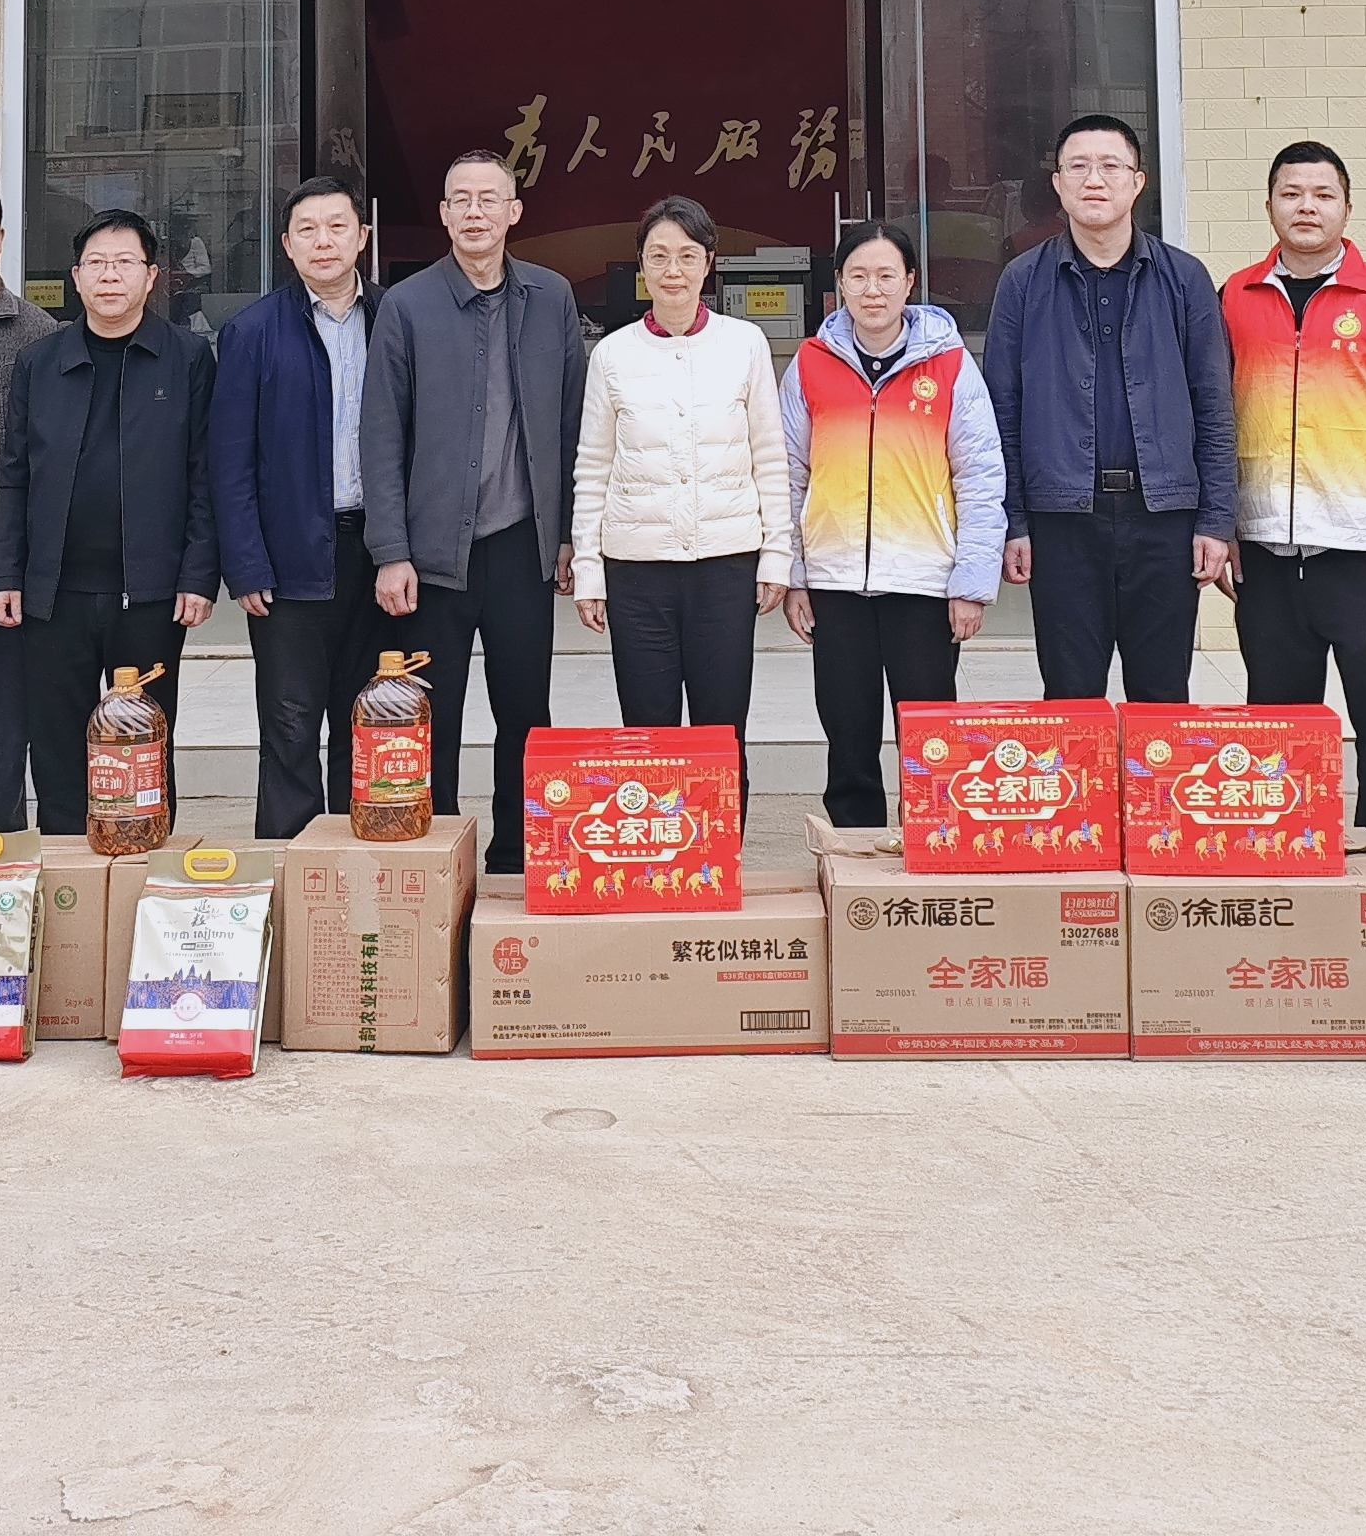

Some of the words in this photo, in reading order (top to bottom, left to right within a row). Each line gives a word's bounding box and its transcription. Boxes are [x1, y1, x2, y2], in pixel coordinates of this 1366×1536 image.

[382, 759, 419, 774] 花生油
[962, 775, 1062, 803] 全家福
[1185, 779, 1287, 807] 全家福
[583, 817, 683, 845] 全家福
[409, 873, 418, 884] 5
[883, 897, 996, 928] 徐福記
[1181, 897, 1295, 928] 徐福記
[1061, 928, 1119, 938] 13027688
[671, 938, 809, 963] 繁花似锦礼盒
[586, 973, 642, 982] 20251210
[926, 955, 1050, 990] 全家福
[1226, 955, 1351, 991] 全家福
